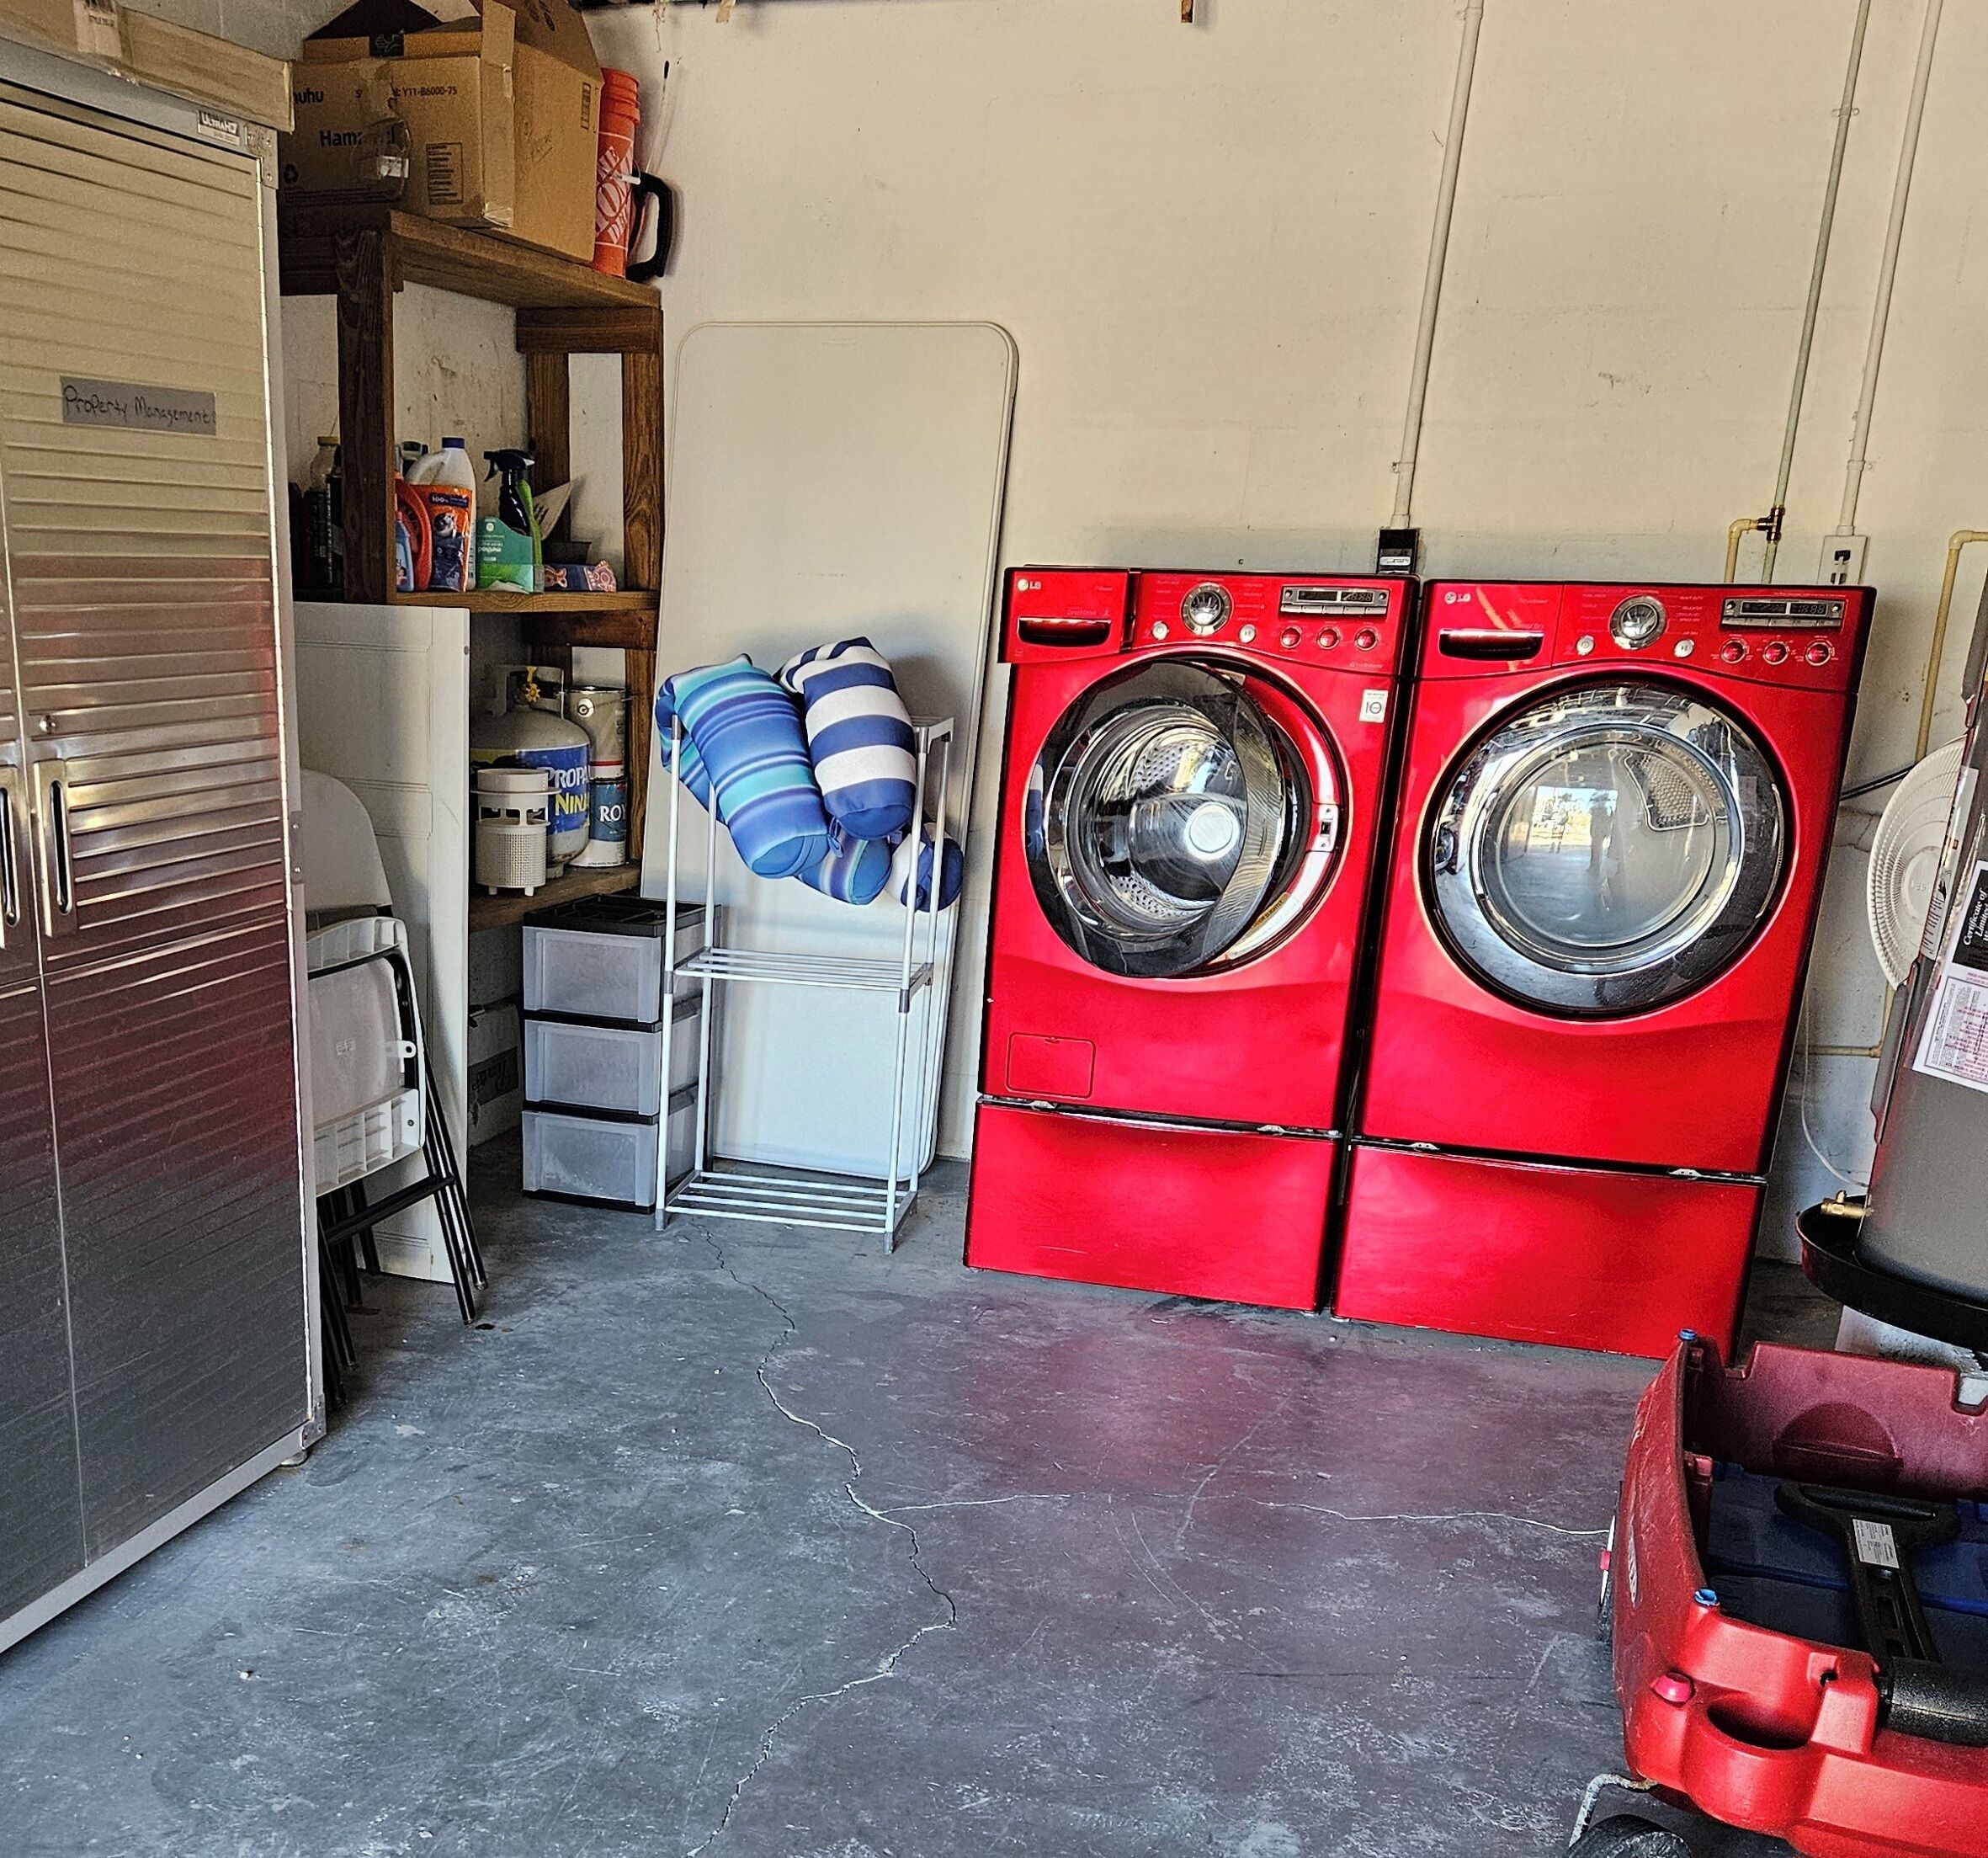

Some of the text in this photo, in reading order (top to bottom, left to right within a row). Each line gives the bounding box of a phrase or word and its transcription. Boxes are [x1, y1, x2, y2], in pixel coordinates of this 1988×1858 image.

[1029, 581, 1042, 590] LG
[1457, 593, 1471, 603] LG
[1963, 887, 1988, 945] Certificate of
